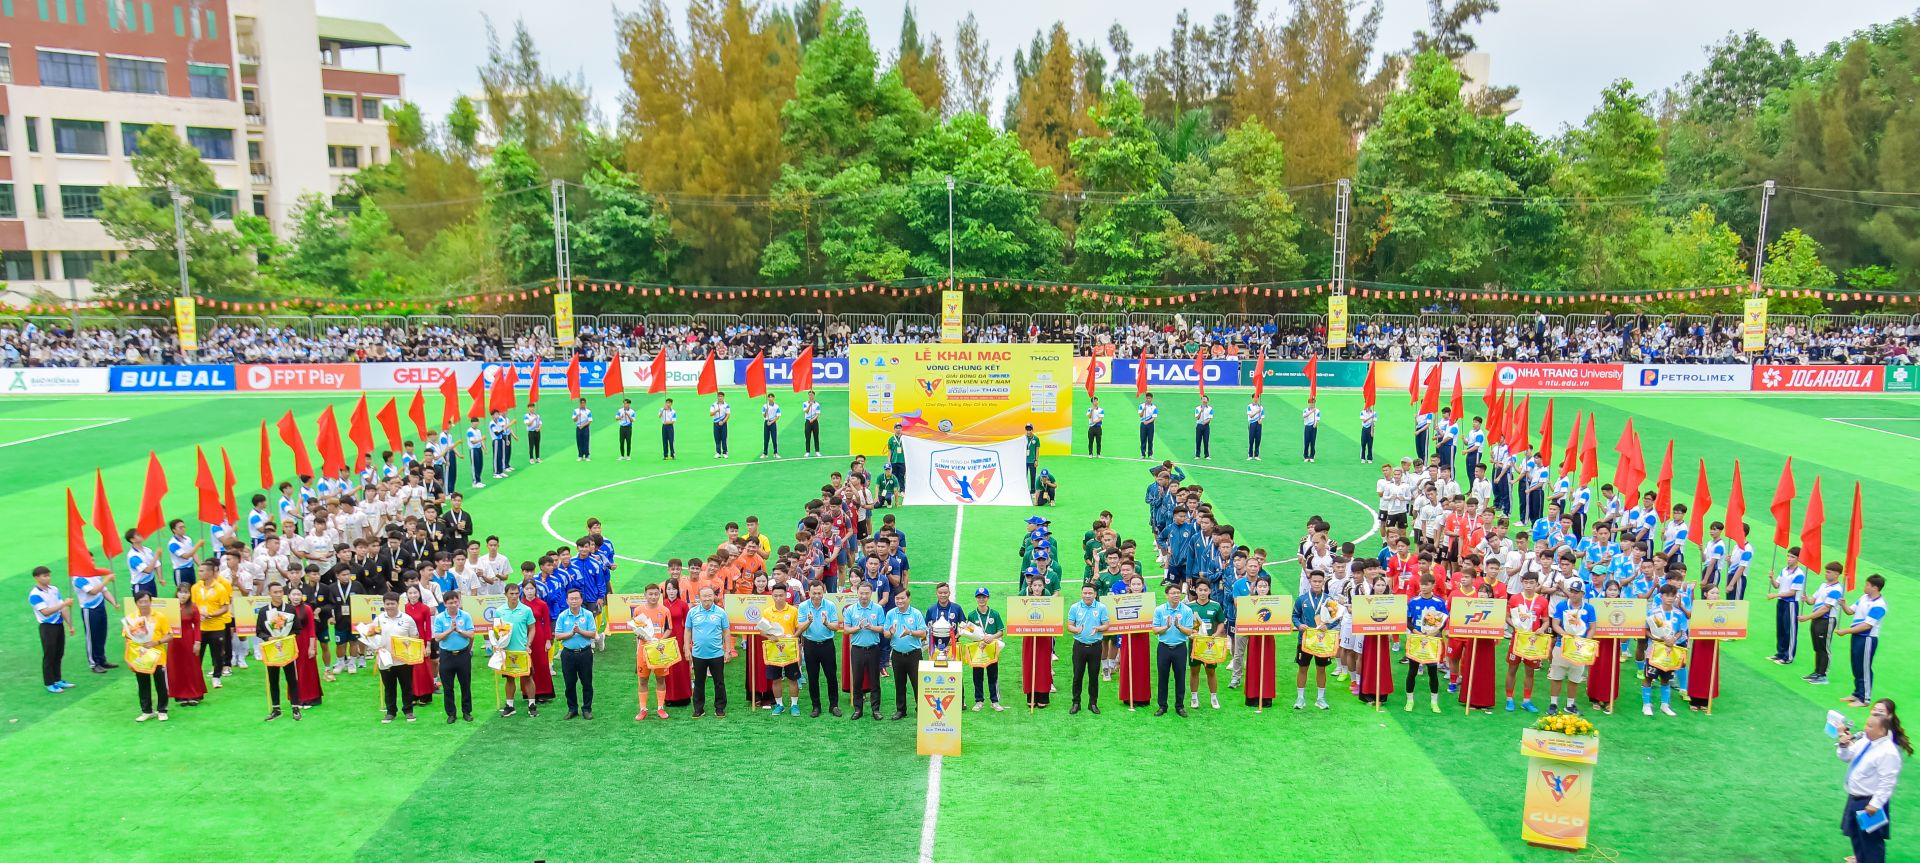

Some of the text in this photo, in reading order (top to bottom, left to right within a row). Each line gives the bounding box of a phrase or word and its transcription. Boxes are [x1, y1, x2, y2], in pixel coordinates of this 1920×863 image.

[937, 351, 972, 361] KHAI
[977, 351, 1012, 362] MẠC
[120, 370, 227, 388] BULBAL
[274, 368, 345, 389] FPT Play
[393, 367, 450, 384] GELEX
[1128, 363, 1221, 382] THACO
[1517, 368, 1623, 380] NHA TRANG University
[1661, 374, 1735, 382] PETROLIMEX
[1785, 369, 1874, 388] JOGARBOLA
[1545, 379, 1590, 387] ntu.edu.vn
